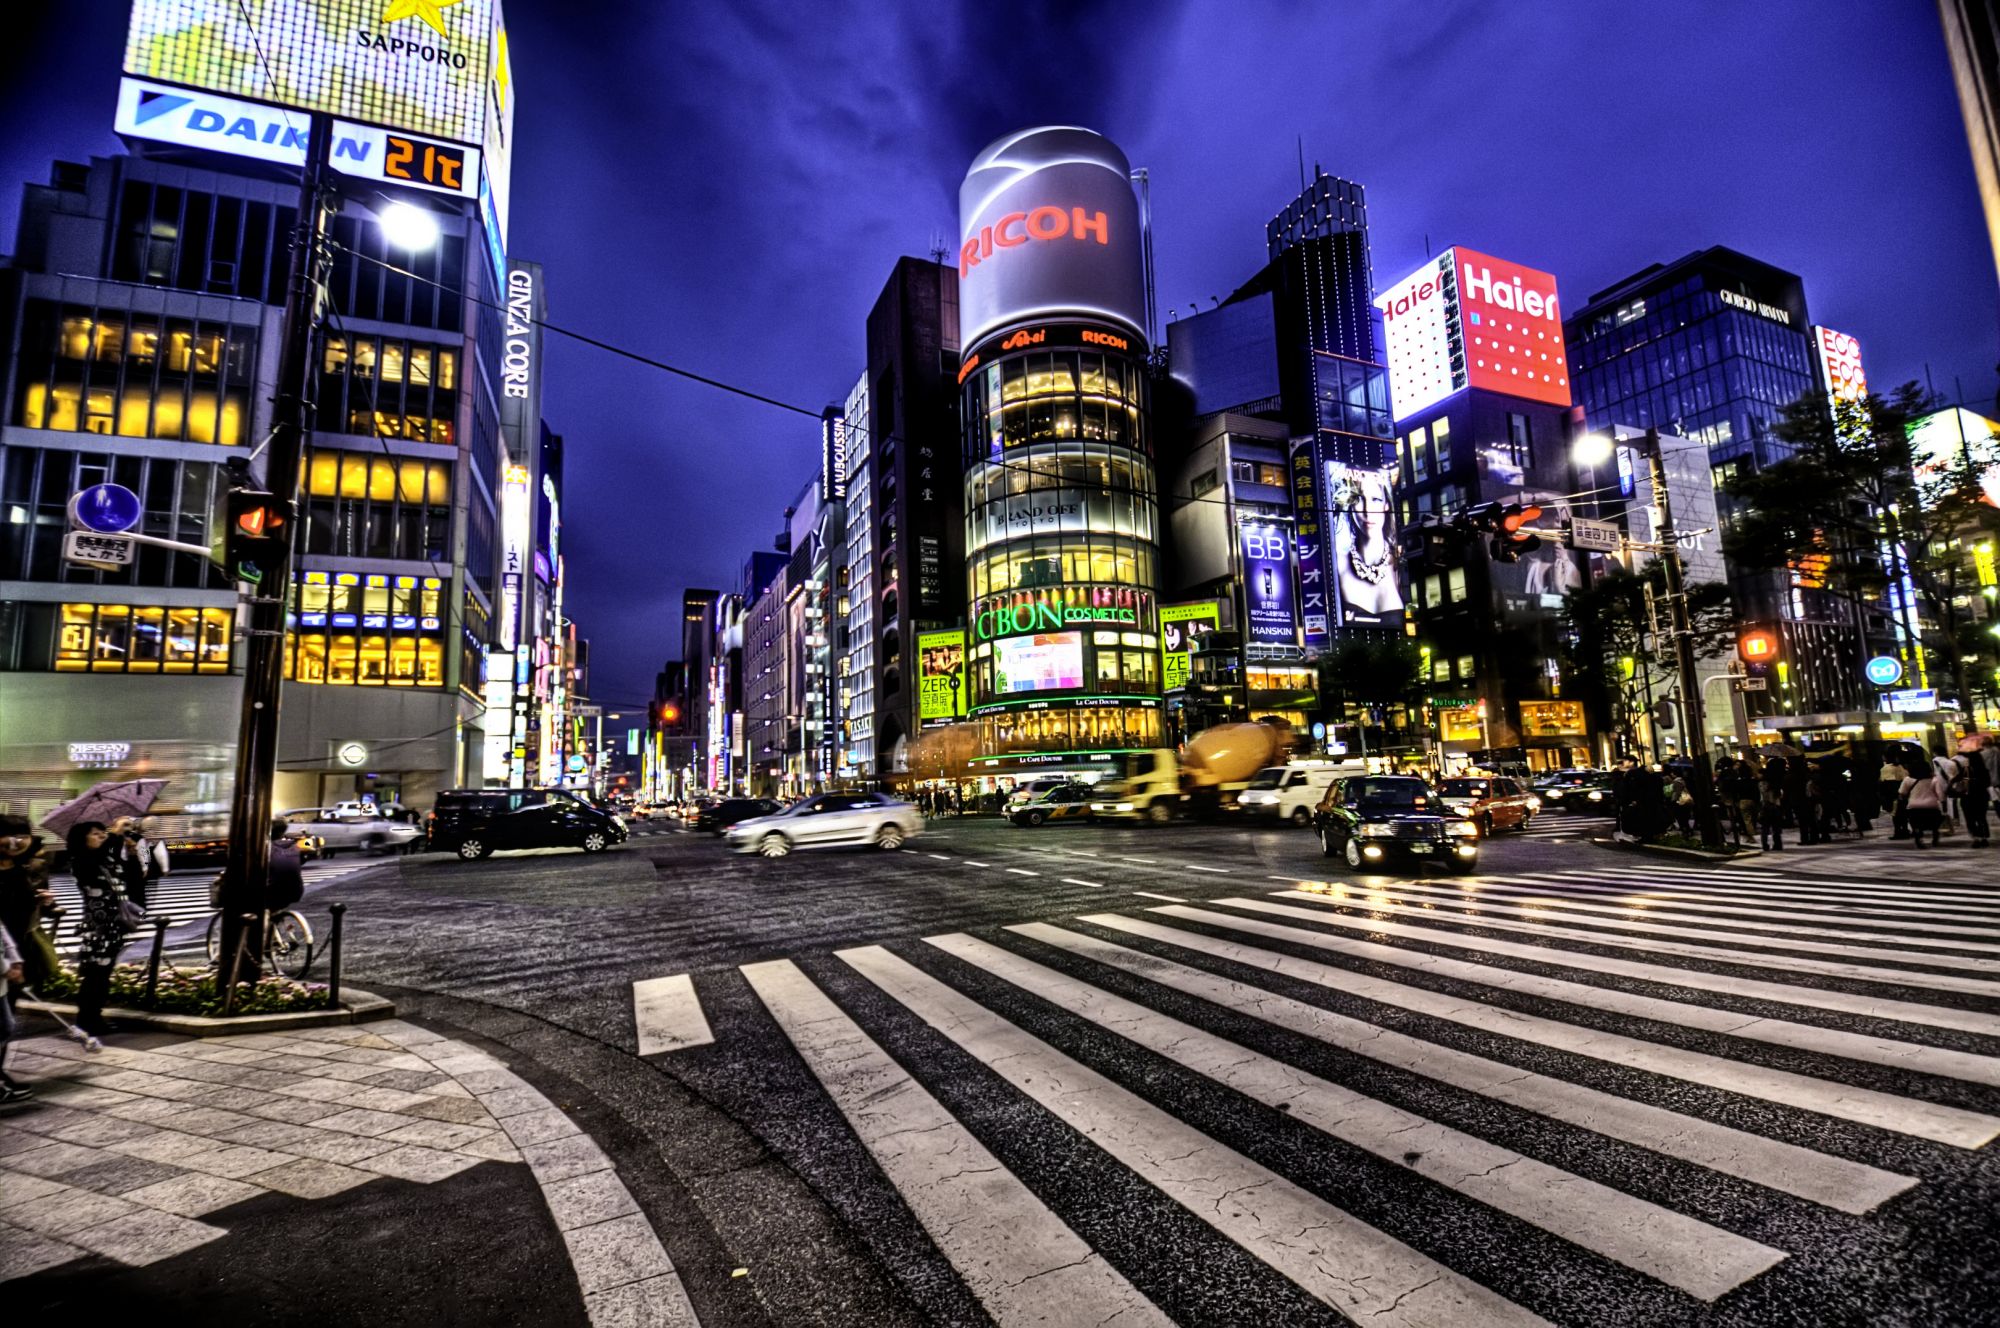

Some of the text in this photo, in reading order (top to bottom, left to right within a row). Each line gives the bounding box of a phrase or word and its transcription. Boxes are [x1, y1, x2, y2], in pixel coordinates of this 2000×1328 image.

[358, 30, 467, 70] SAPPORO
[185, 108, 373, 162] DAIKN
[959, 205, 1108, 280] RICOH
[1383, 271, 1444, 321] Haier
[1463, 262, 1557, 321] Haier
[1720, 289, 1790, 325] GIORGIO ARMANI
[504, 270, 532, 399] GINZA CORE
[1081, 330, 1128, 350] RICOH
[1822, 327, 1862, 360] ECC
[1827, 356, 1868, 386] ECC
[998, 503, 1078, 526] BRAND OFF
[1016, 517, 1054, 528] TOKYO
[1246, 534, 1285, 561] B.B
[1300, 544, 1324, 609] ジオス
[302, 614, 416, 629] イーオン
[1064, 607, 1135, 622] COSMETICS
[1252, 626, 1293, 636] HANSKIN
[69, 743, 129, 753] NISSAN
